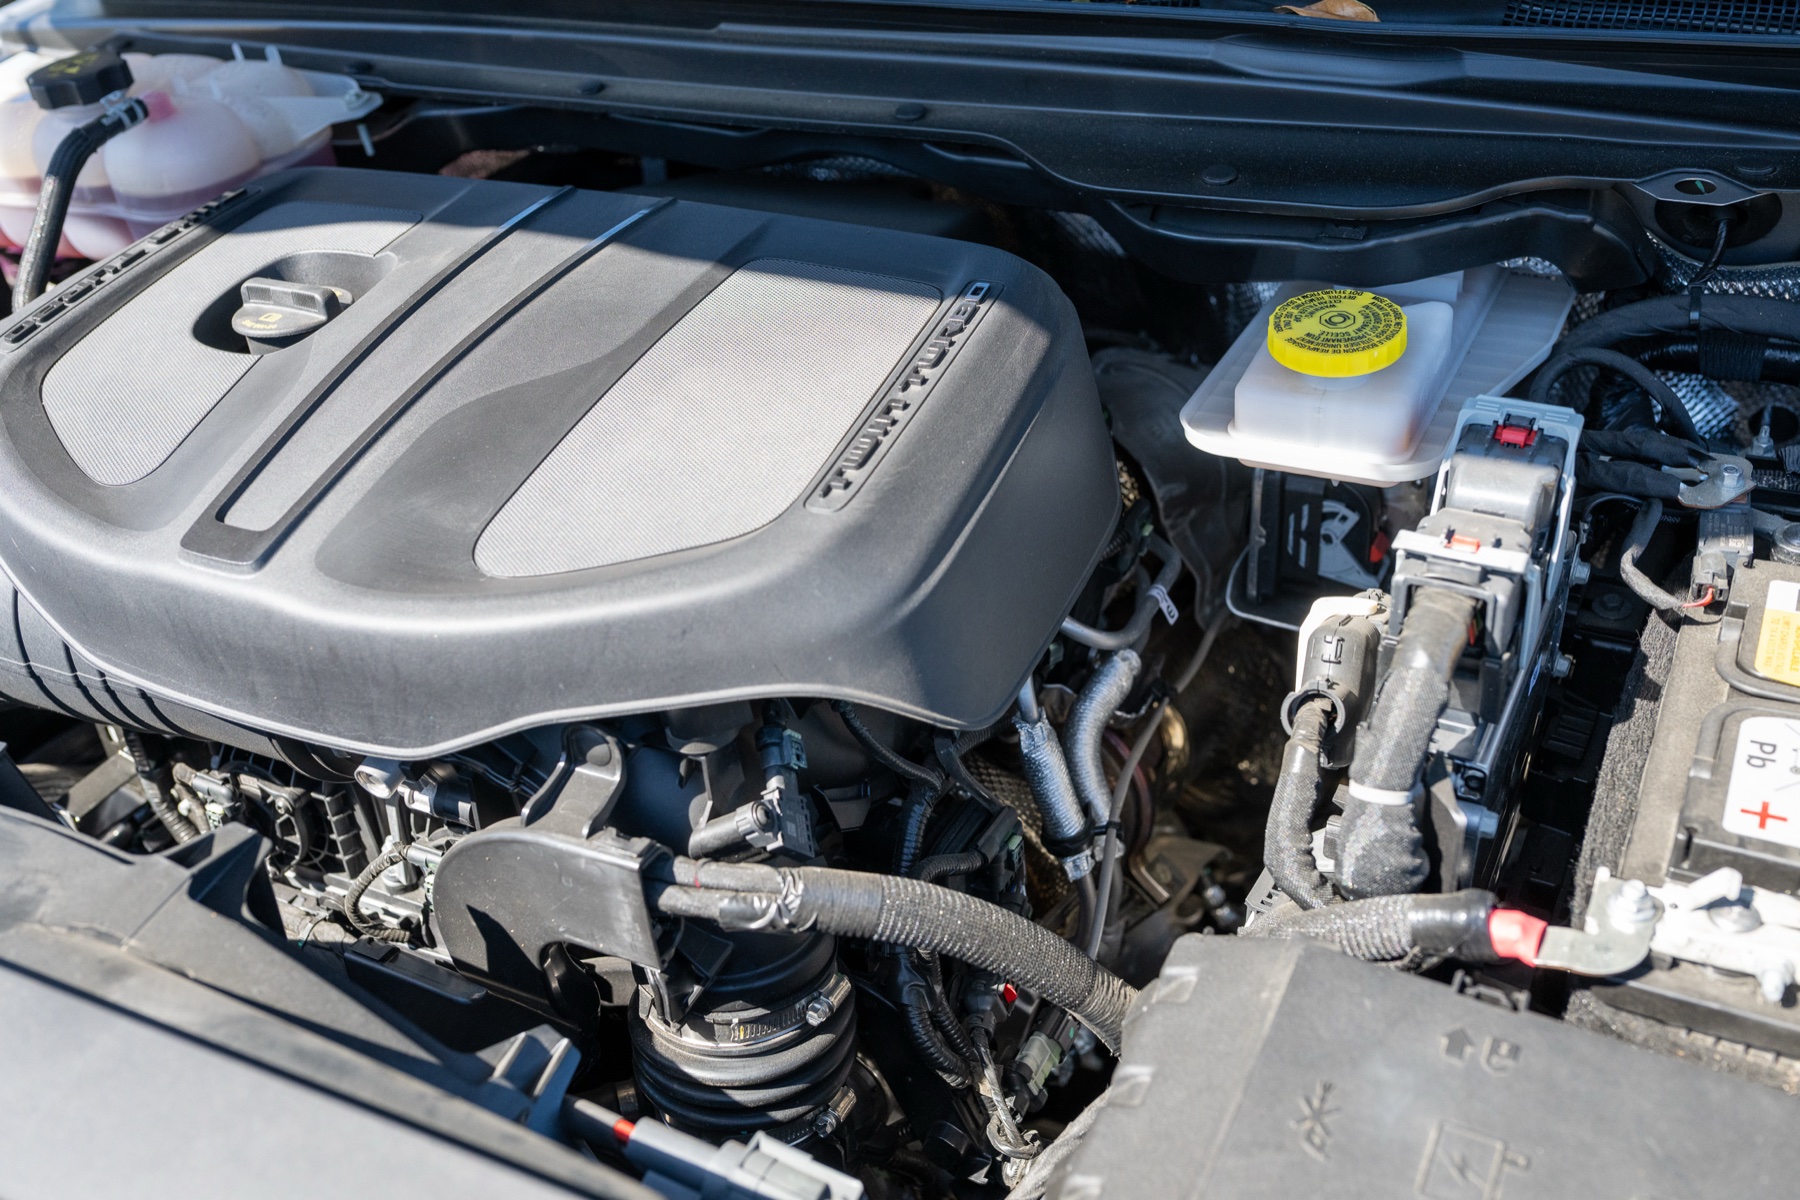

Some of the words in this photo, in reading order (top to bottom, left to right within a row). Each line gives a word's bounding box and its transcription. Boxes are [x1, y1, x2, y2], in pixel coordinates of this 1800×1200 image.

[4, 249, 147, 343] TURBO
[1301, 291, 1320, 299] FROM
[1371, 295, 1388, 303] MISE
[1278, 300, 1298, 311] SEALED
[1369, 301, 1388, 311] AVANT
[1353, 310, 1371, 334] CONTENANT
[1295, 336, 1341, 348] UNIQUEMENT
[1321, 334, 1366, 343] PROVENANT
[1343, 337, 1374, 348] UTILISER
[1285, 337, 1329, 353] REMPLISSAGE
[1343, 343, 1379, 353] BOUCHON
[818, 398, 911, 498] TWIN
[897, 281, 993, 392] TURBO
[1746, 740, 1776, 768] Pb
